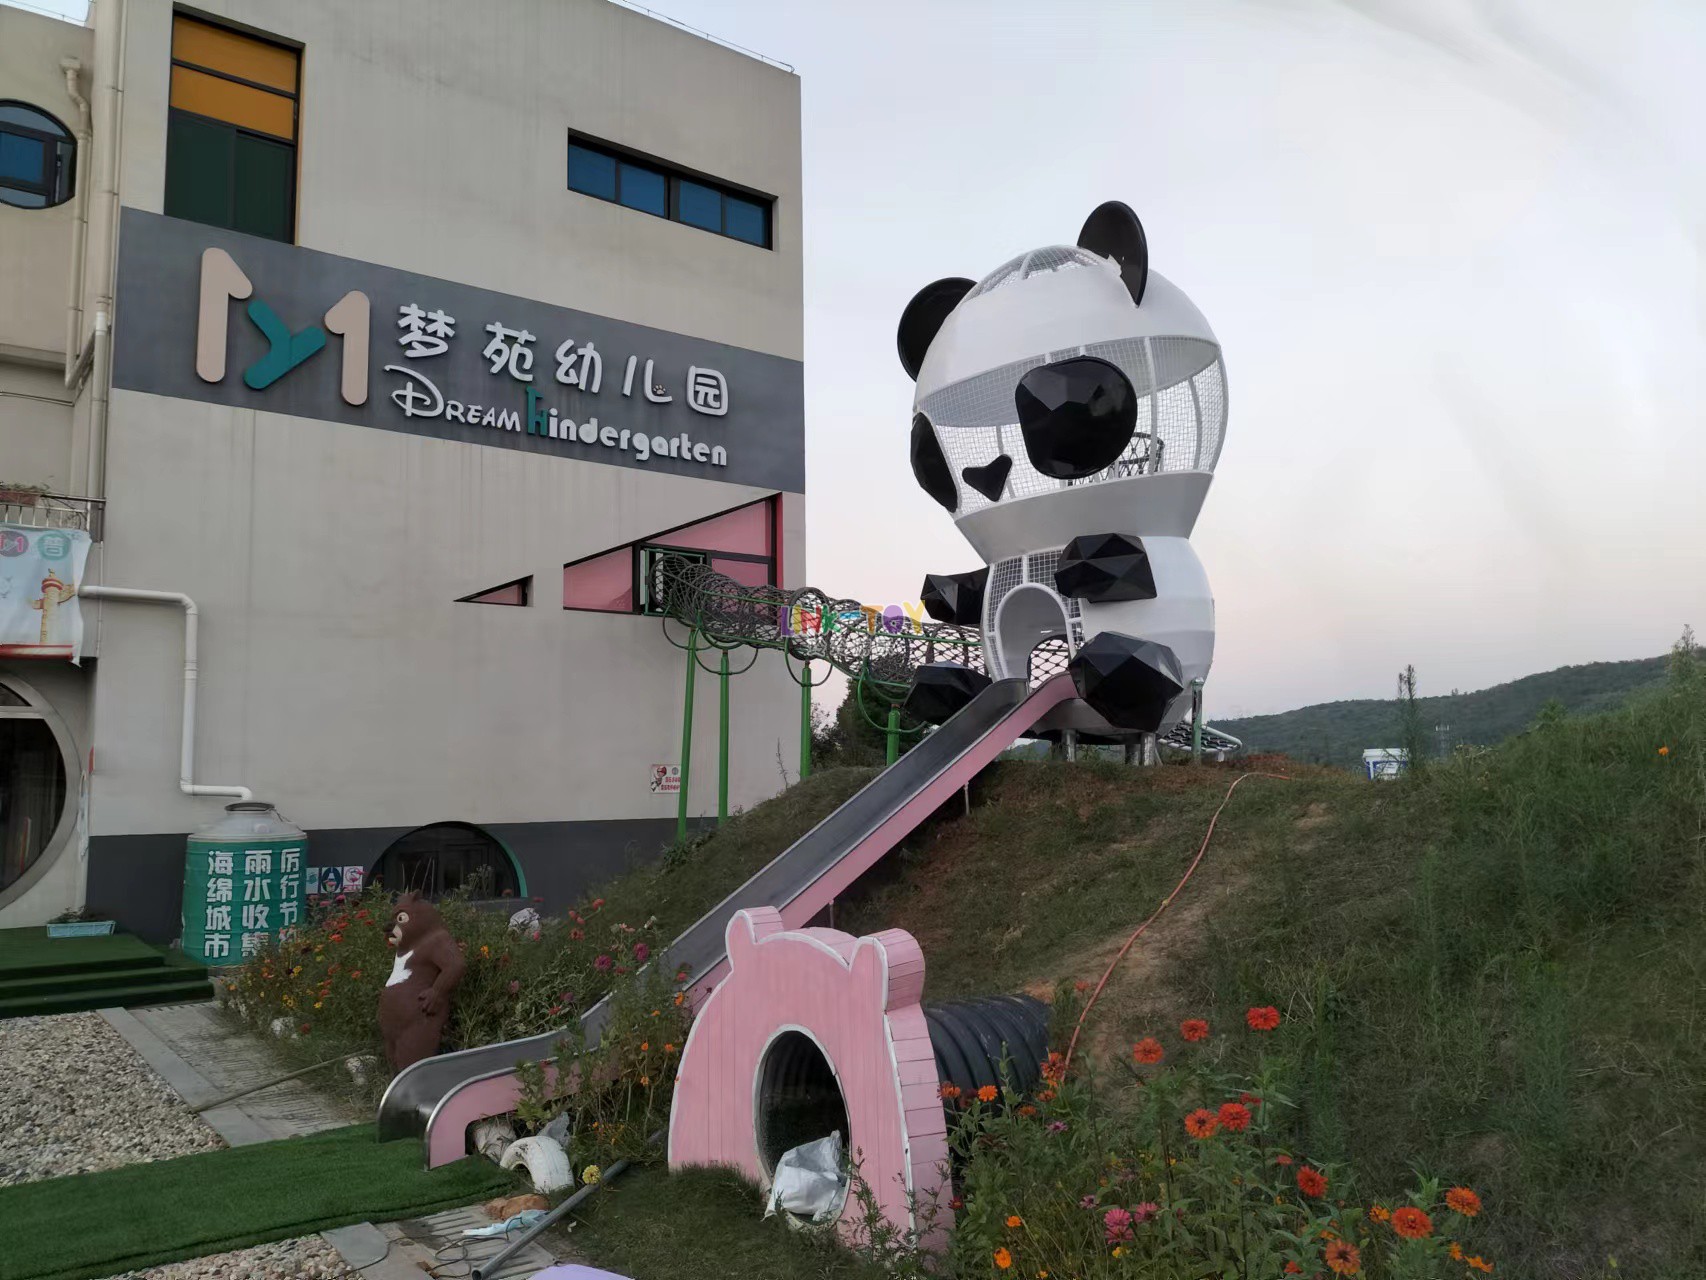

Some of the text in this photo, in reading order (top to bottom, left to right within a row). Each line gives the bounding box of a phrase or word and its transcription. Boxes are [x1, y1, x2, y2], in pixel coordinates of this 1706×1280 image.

[398, 303, 729, 416] 梦苑幼儿园
[204, 850, 234, 958] 海绵城市
[279, 848, 301, 938] 厉行节
